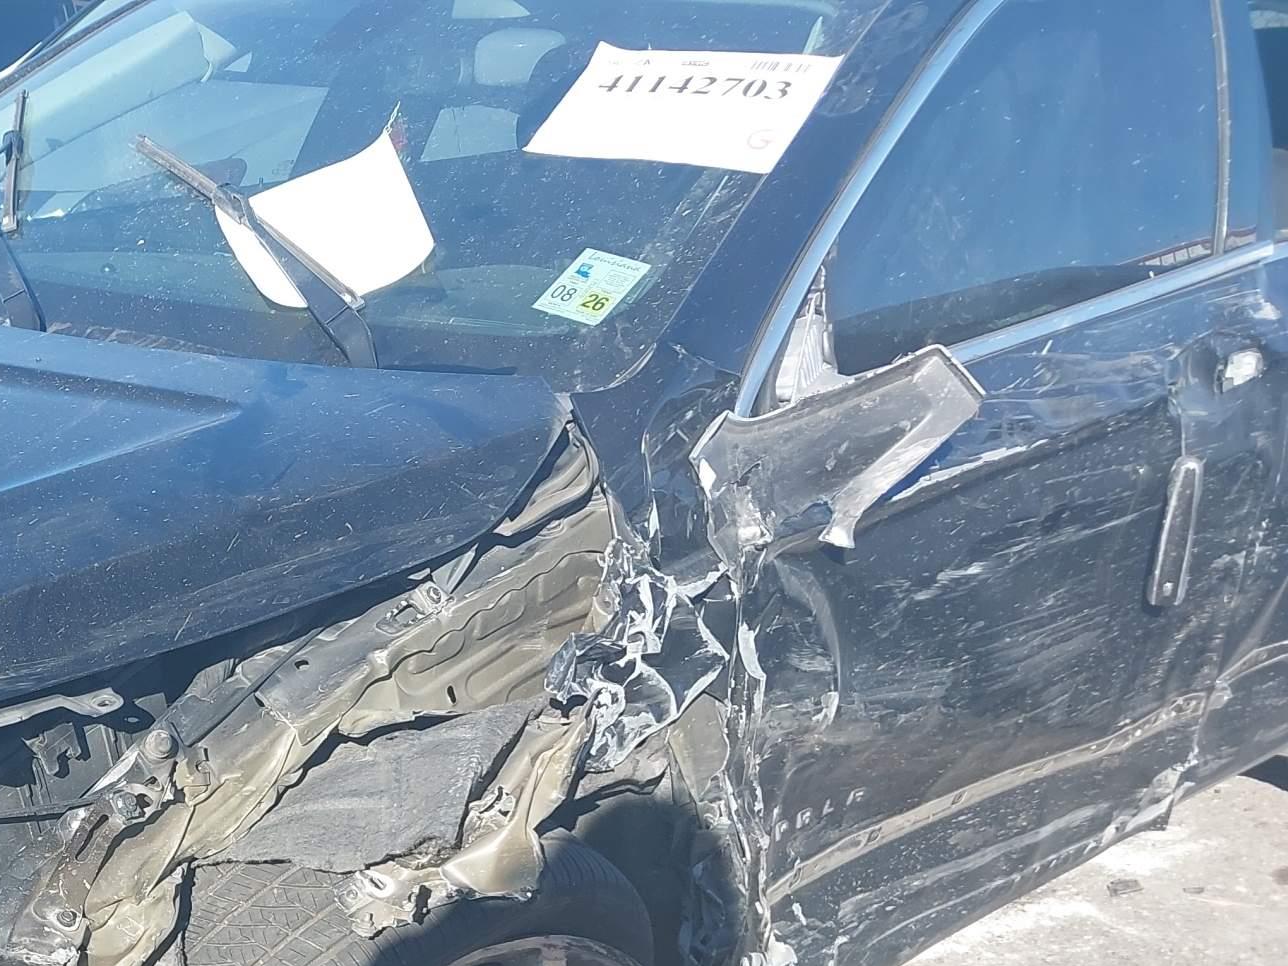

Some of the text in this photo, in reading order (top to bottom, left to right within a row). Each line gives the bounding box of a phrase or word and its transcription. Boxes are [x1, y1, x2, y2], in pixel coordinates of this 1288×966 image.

[598, 74, 792, 100] 41142703
[550, 284, 577, 302] 08
[580, 293, 610, 312] 26
